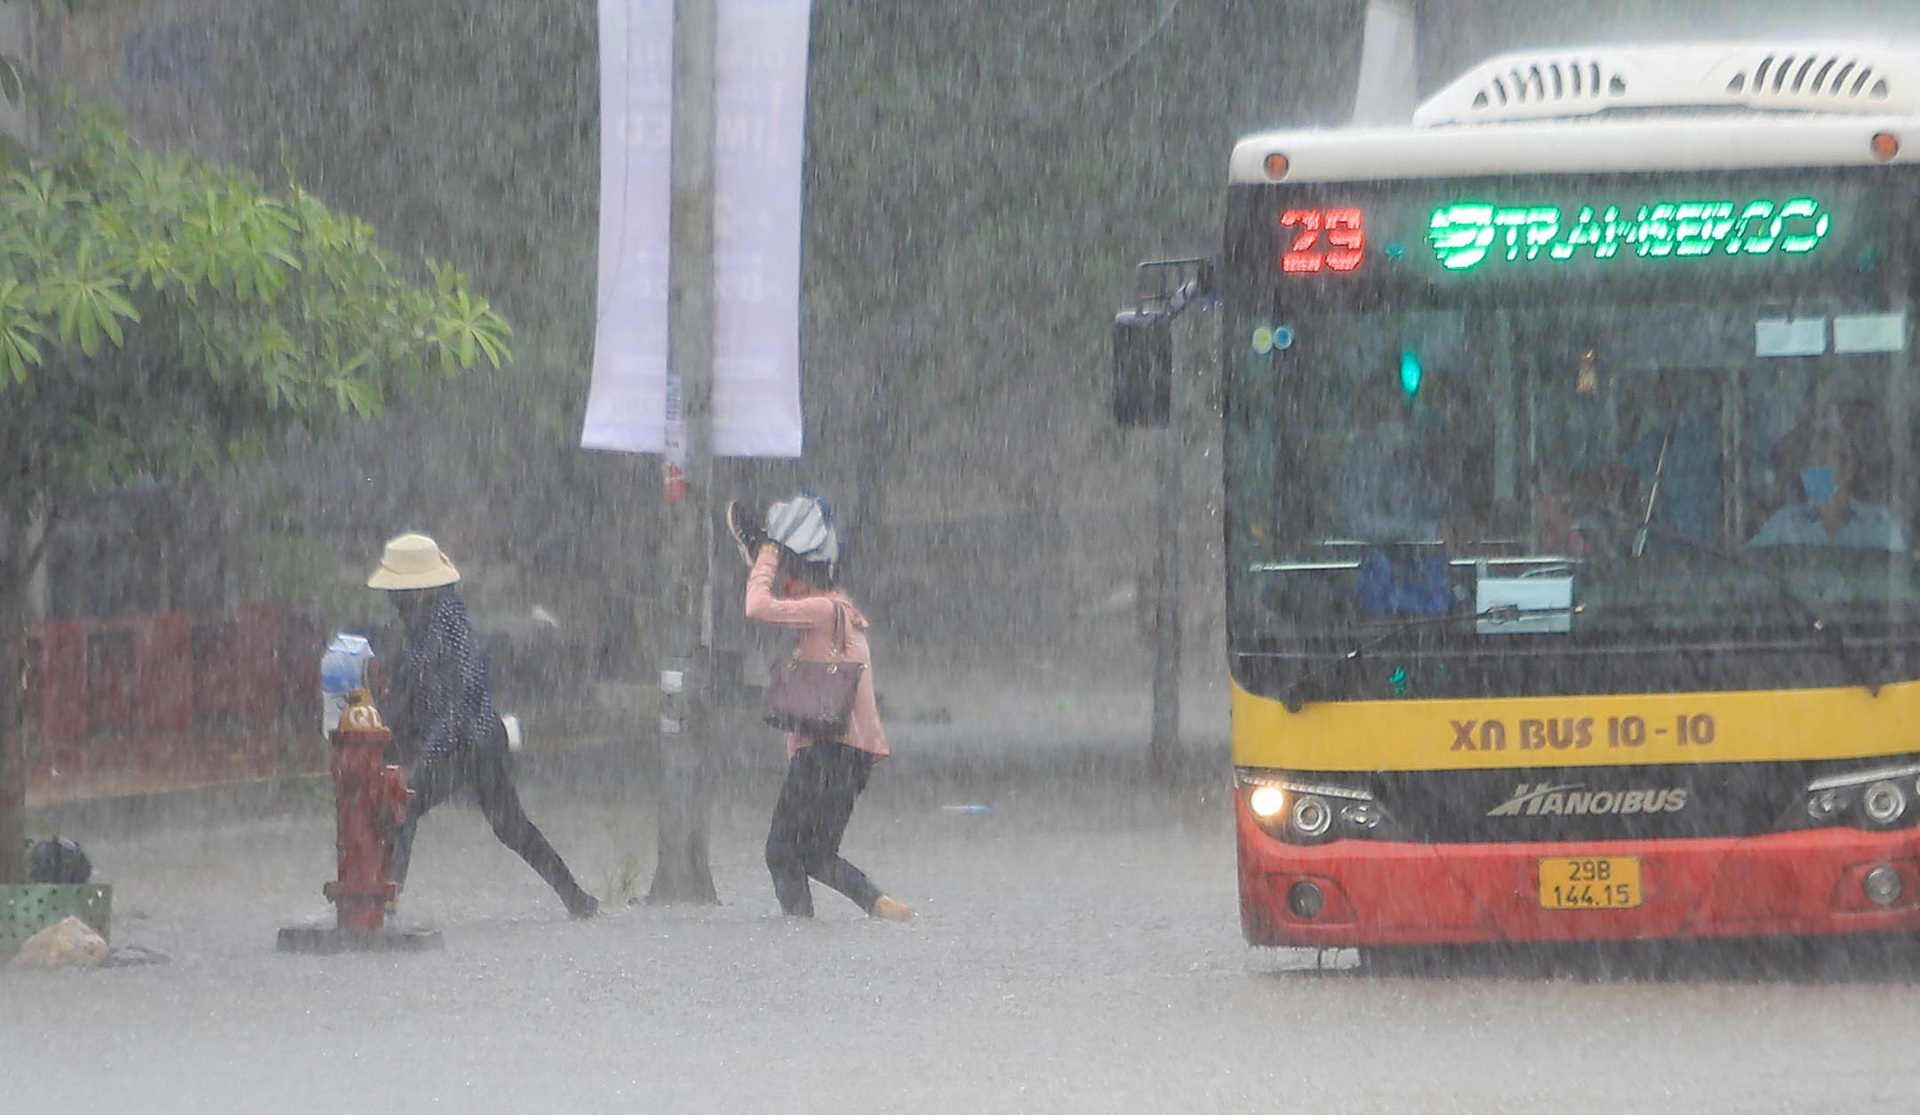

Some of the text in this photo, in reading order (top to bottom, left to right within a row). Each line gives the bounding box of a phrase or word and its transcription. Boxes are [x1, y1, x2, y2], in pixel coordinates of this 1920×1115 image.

[1279, 207, 1364, 272] 29
[1519, 717, 1595, 750] BUS
[1608, 715, 1647, 748] 10
[1676, 714, 1716, 746] 10
[1486, 782, 1688, 818] HANOIBUS
[1568, 860, 1612, 882] 29B
[1553, 884, 1630, 907] 144.15
